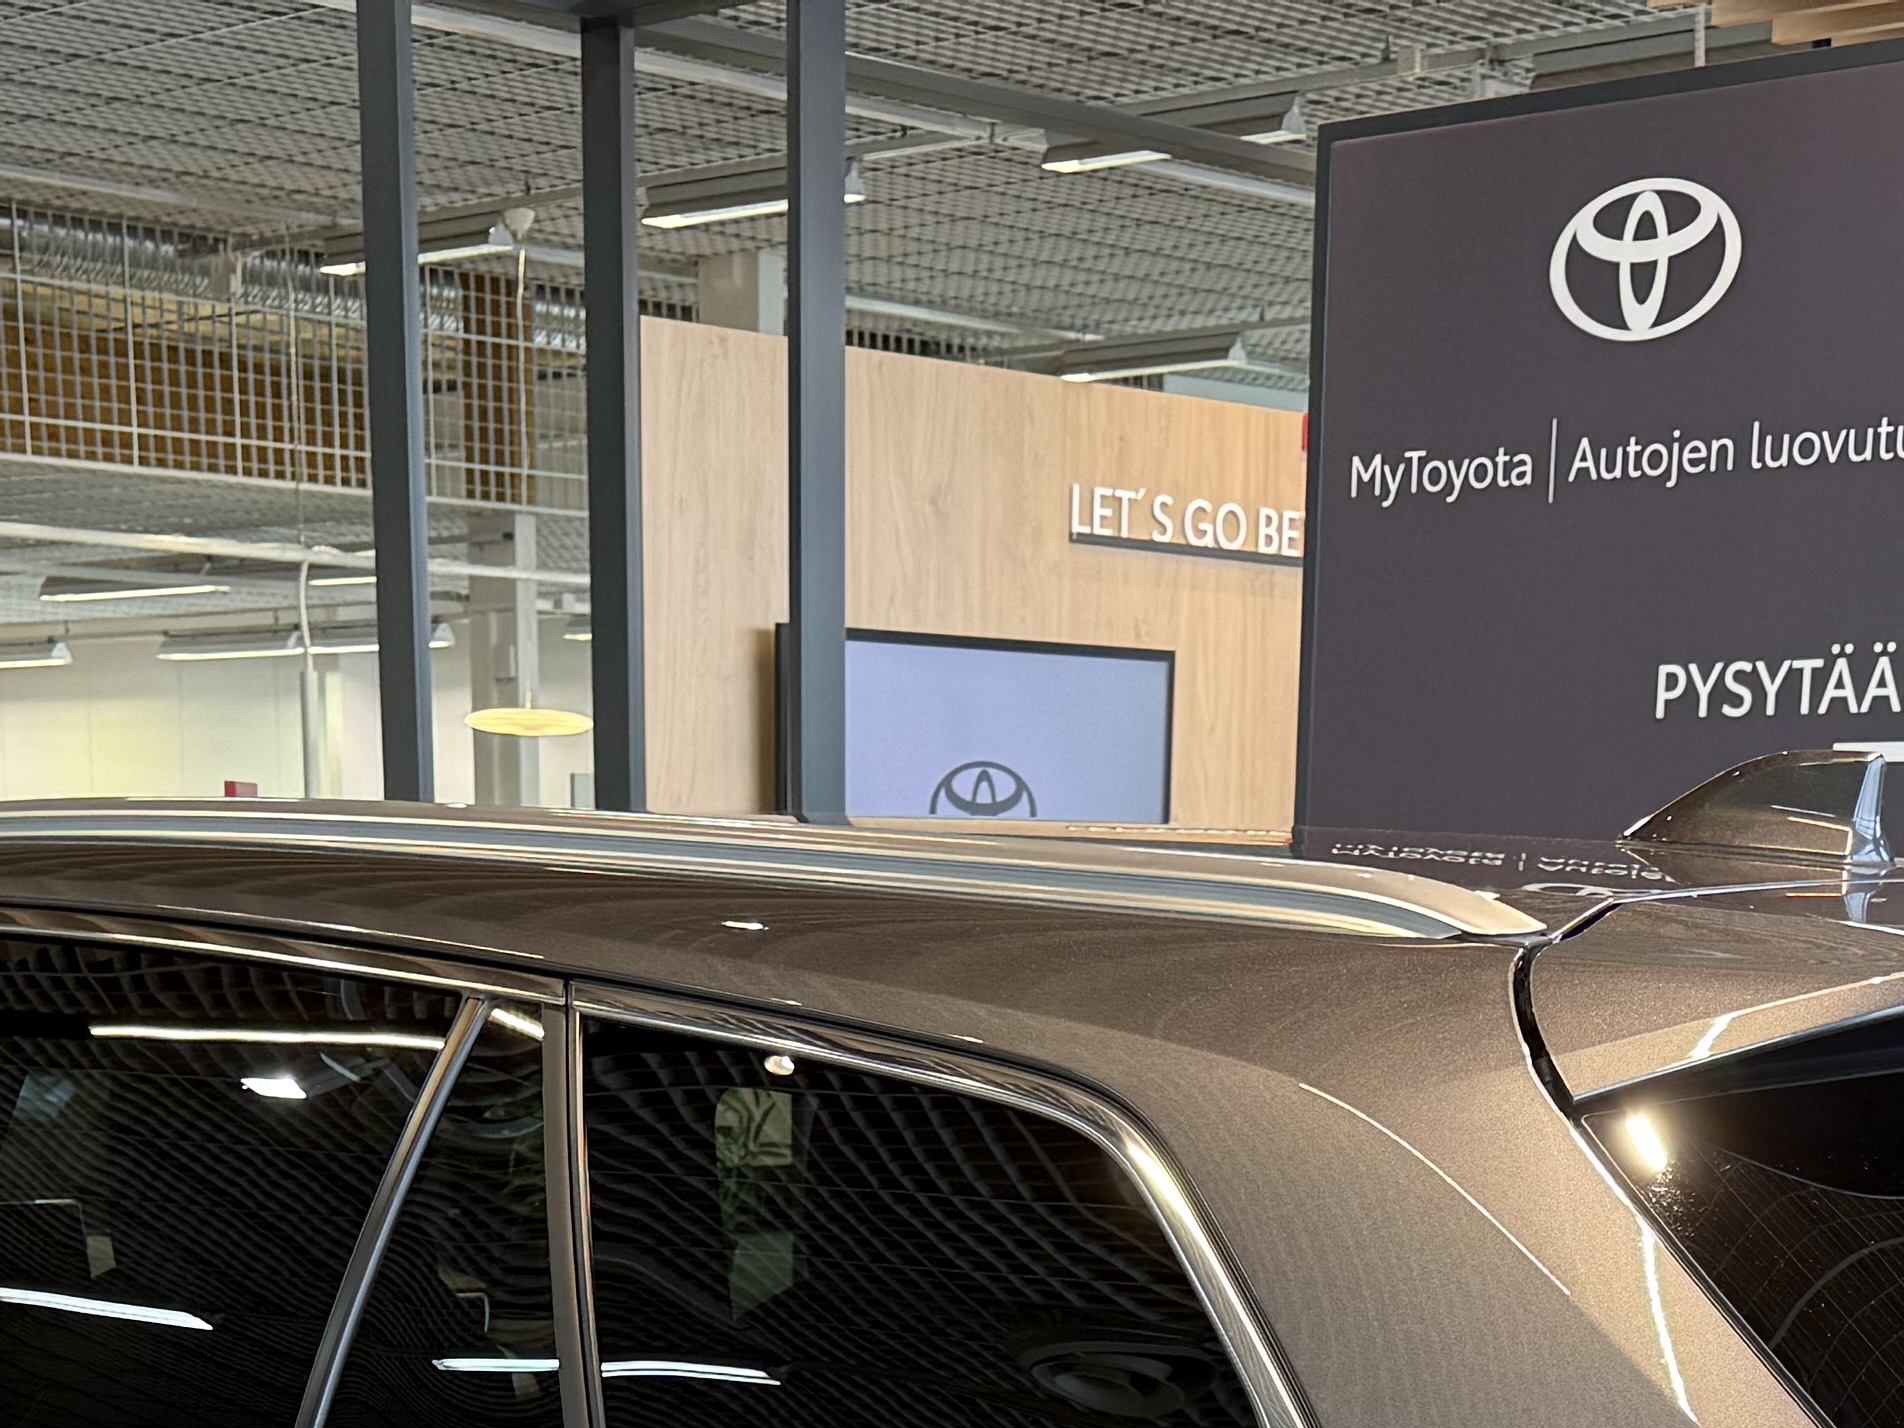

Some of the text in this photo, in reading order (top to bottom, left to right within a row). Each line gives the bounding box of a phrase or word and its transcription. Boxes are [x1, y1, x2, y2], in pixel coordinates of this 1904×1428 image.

[1351, 447, 1533, 508] MyToyota
[1568, 427, 1735, 489] Autojen
[1184, 498, 1247, 550] GO
